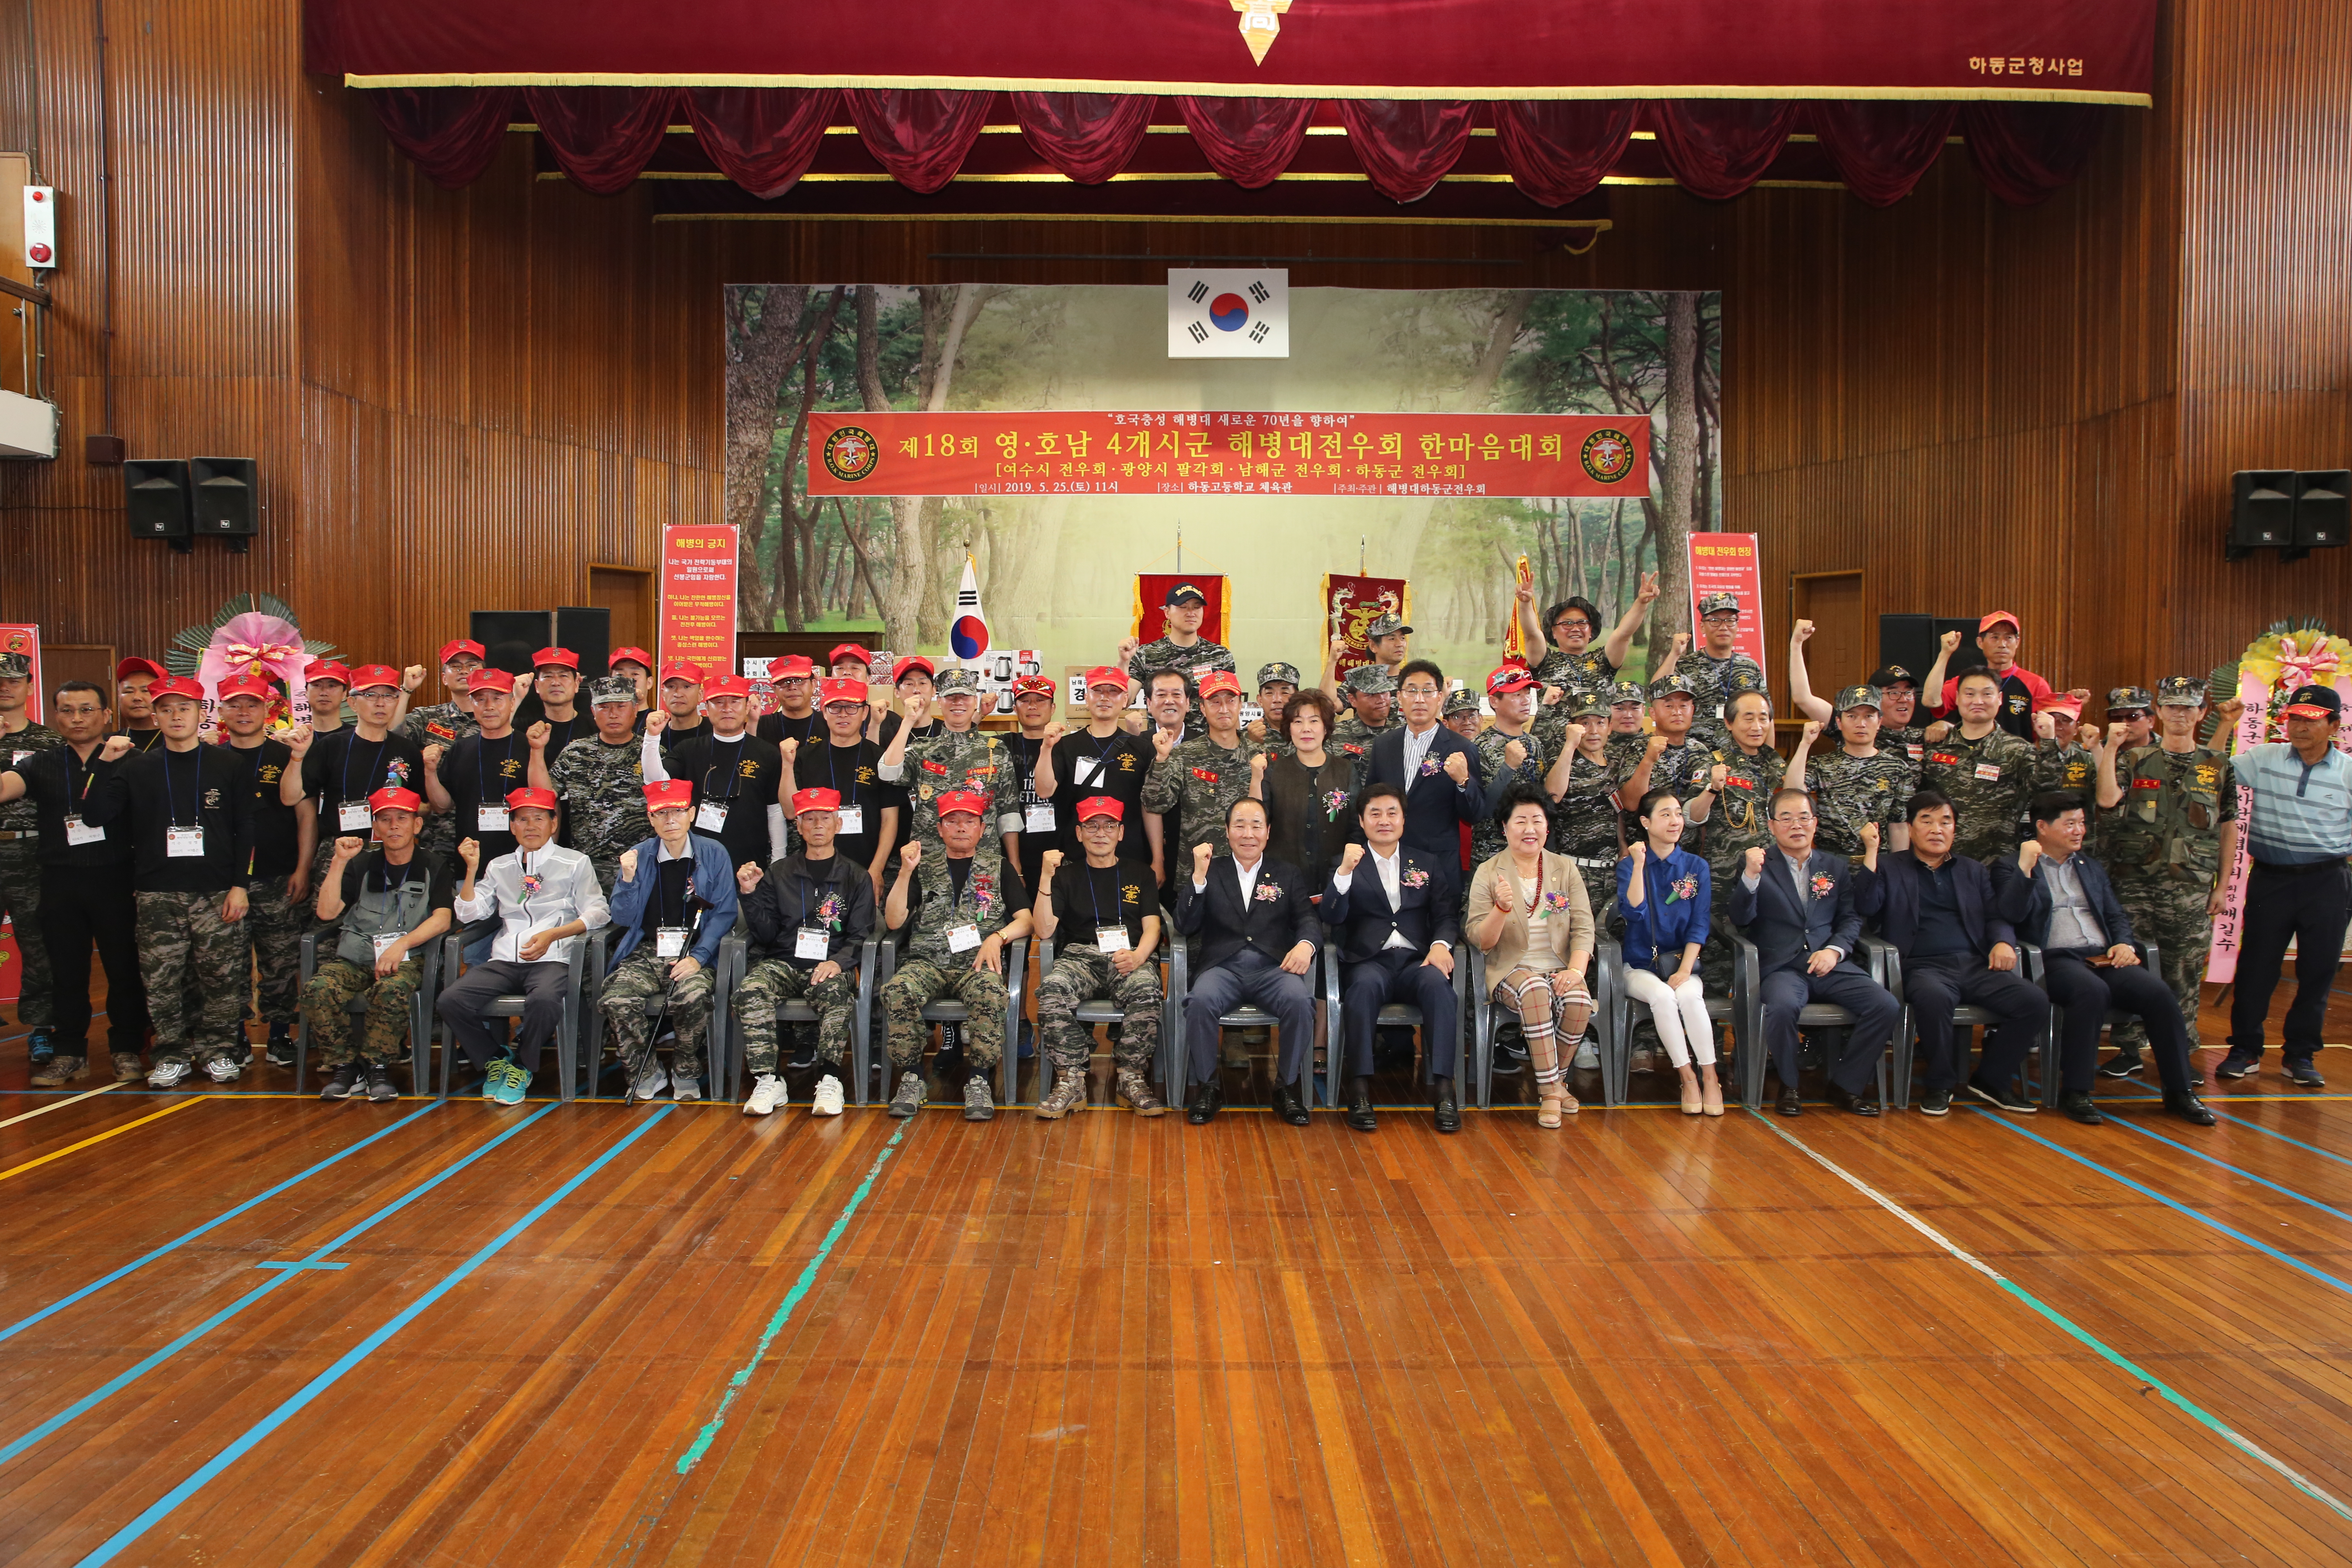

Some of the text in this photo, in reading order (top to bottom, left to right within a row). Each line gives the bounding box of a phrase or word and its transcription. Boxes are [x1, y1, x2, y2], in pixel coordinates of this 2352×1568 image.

[1173, 414, 1211, 426] 해병대
[1217, 414, 1256, 426] 새로운
[1262, 414, 1304, 427] 70년을
[898, 433, 978, 459] 제18회
[1106, 430, 1212, 459] 4개시군
[1227, 431, 1402, 461] 해병대전우회
[1418, 432, 1561, 462] 한마음대회
[838, 470, 862, 479] MARINE
[861, 457, 875, 474] CORPS
[996, 462, 1050, 477] [여수시
[1411, 464, 1465, 479] 전우회]
[1595, 472, 1618, 481] MARINE
[1617, 459, 1631, 477] CORPS
[1005, 482, 1035, 492] 2019.
[1039, 482, 1049, 492] 5.
[1053, 481, 1090, 493] 25.(토)
[1095, 481, 1118, 493] 11시
[1187, 481, 1255, 493] 하동고등학교
[1259, 481, 1293, 493] 체육관
[1386, 483, 1486, 494] 해병대하동군전우회
[676, 539, 726, 548] 해병의 긍지
[1695, 546, 1715, 556] 해병대
[1717, 547, 1736, 556] 전우회
